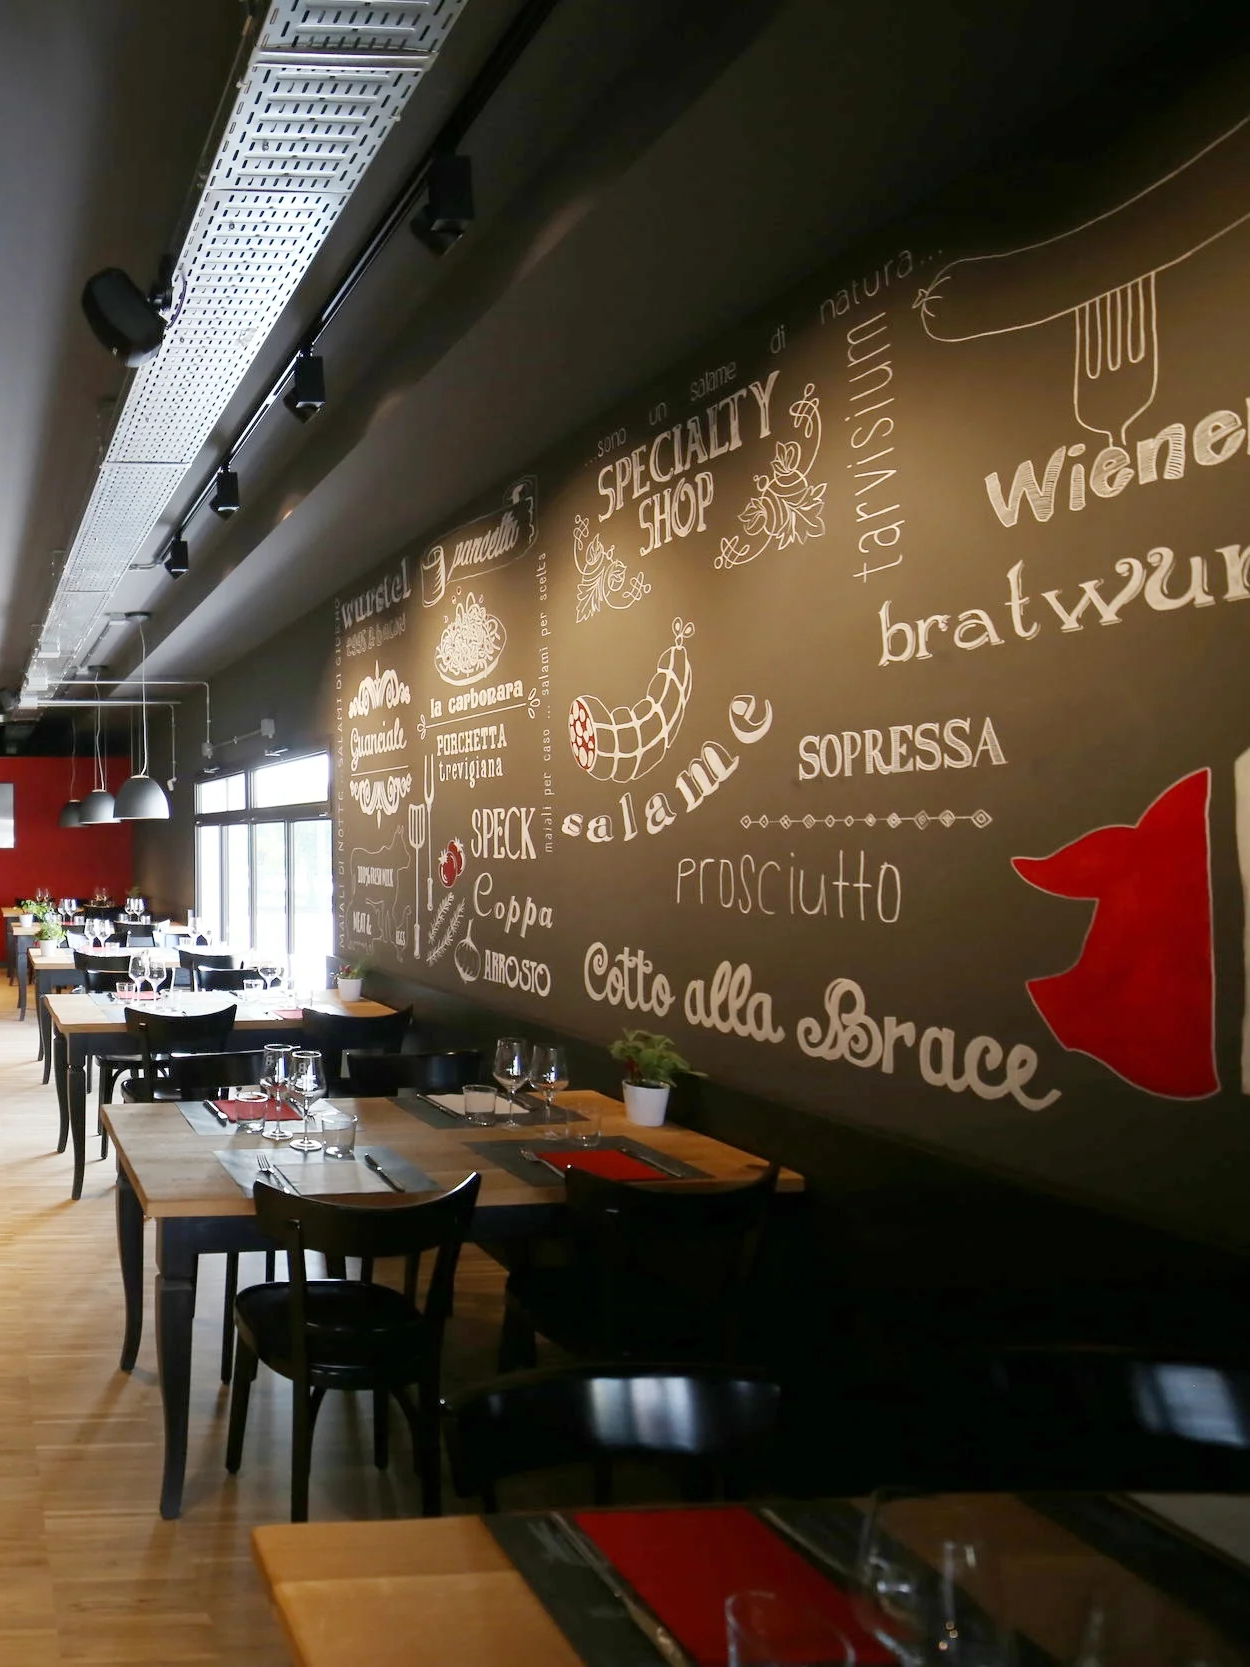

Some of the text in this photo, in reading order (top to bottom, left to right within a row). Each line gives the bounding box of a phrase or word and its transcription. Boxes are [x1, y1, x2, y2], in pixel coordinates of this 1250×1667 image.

[649, 401, 667, 427] un
[690, 360, 737, 403] salame
[769, 324, 787, 354] di
[597, 370, 781, 523] SPECIALTY
[844, 311, 905, 584] tarvisium
[984, 397, 1250, 529] Wiene
[638, 470, 715, 557] SHOP
[535, 552, 547, 601] scelta
[539, 612, 552, 636] per
[336, 673, 342, 690] DI
[538, 646, 550, 696] salami
[430, 679, 524, 719] la carbonara
[351, 716, 408, 771] Guanciale
[436, 723, 507, 757] PORCHETTA
[542, 729, 551, 761] caso
[797, 717, 1008, 781] SOPRESSA
[438, 757, 504, 788] trevigiana
[543, 773, 554, 796] per
[560, 694, 774, 843] salame
[471, 806, 537, 860] SPECK
[541, 806, 553, 853] maiali
[338, 861, 345, 875] DI
[473, 872, 553, 938] Coppa
[484, 949, 551, 997] ARROSTO
[583, 941, 1062, 1112] Cotto alla Brace
